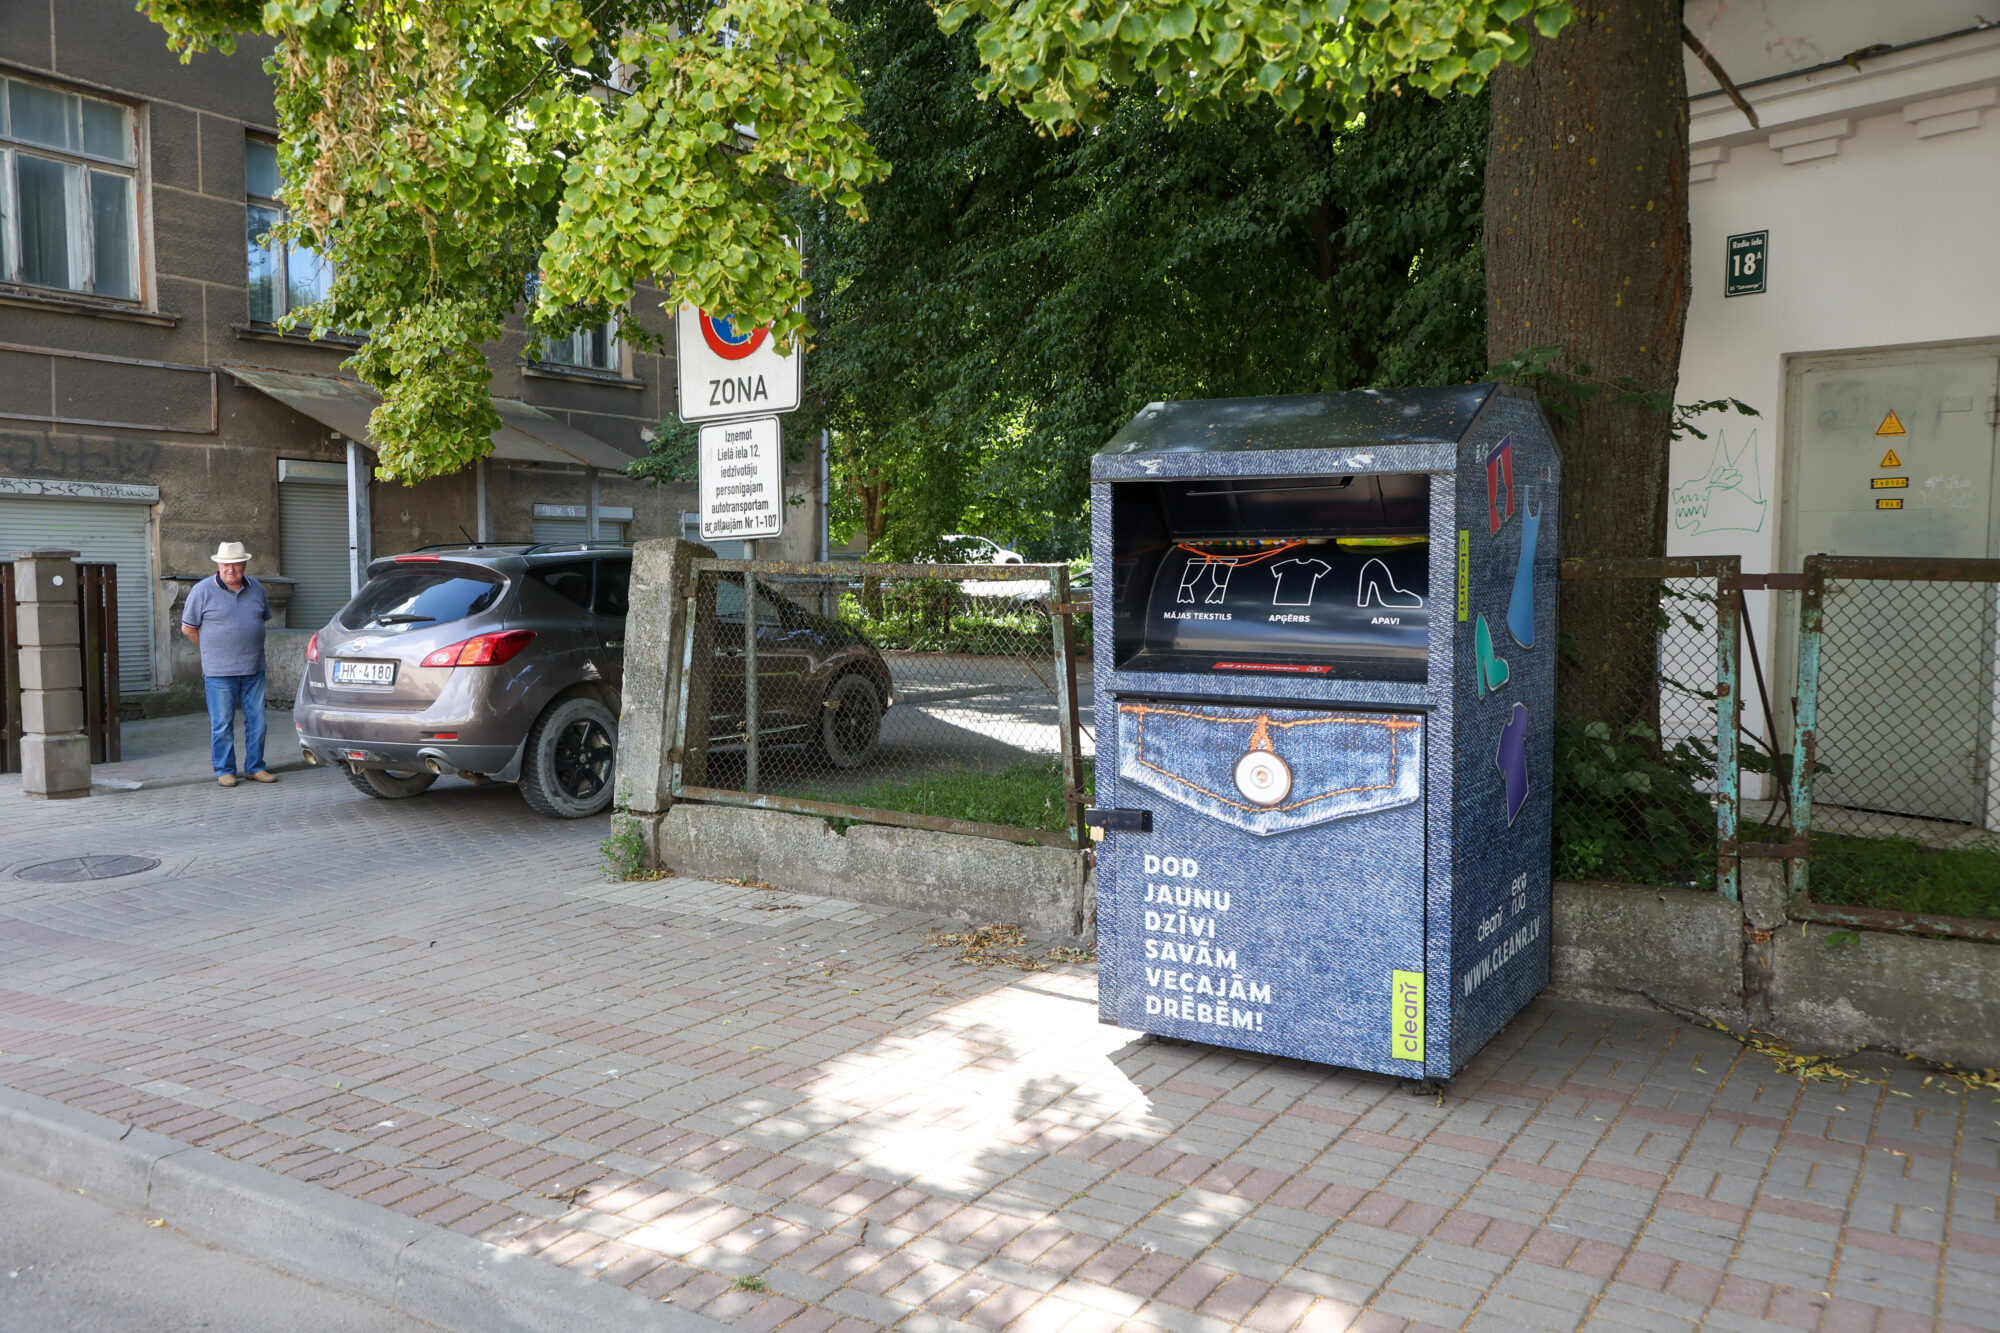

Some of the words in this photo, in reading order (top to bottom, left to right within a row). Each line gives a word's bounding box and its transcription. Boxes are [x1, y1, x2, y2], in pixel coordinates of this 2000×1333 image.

[709, 374, 768, 406] ZONA
[725, 428, 752, 445] Izņemot
[717, 447, 734, 461] Lielā
[735, 446, 748, 459] iela
[720, 463, 758, 478] iedzīvotāju
[716, 481, 763, 499] personīgajam
[711, 499, 769, 515] autotransportam
[704, 522, 712, 532] ar
[713, 517, 743, 534] atļaujām
[744, 516, 754, 529] Nr
[755, 514, 777, 529] 1-107
[1163, 611, 1192, 620] MĀJAS
[1194, 612, 1232, 621] TEKSTILS
[1268, 613, 1311, 624] APĢĒRBS
[1371, 616, 1400, 625] APAVI
[1144, 854, 1199, 878] DOD
[1144, 883, 1230, 911] JAUNU
[1145, 909, 1215, 938] DZĪVI
[1145, 939, 1237, 970] SAVĀM
[1463, 915, 1540, 998] WWW.CLEANR.LV
[1145, 967, 1271, 1004] VECAJĀM
[1146, 995, 1263, 1032] DRĒBĒM!
